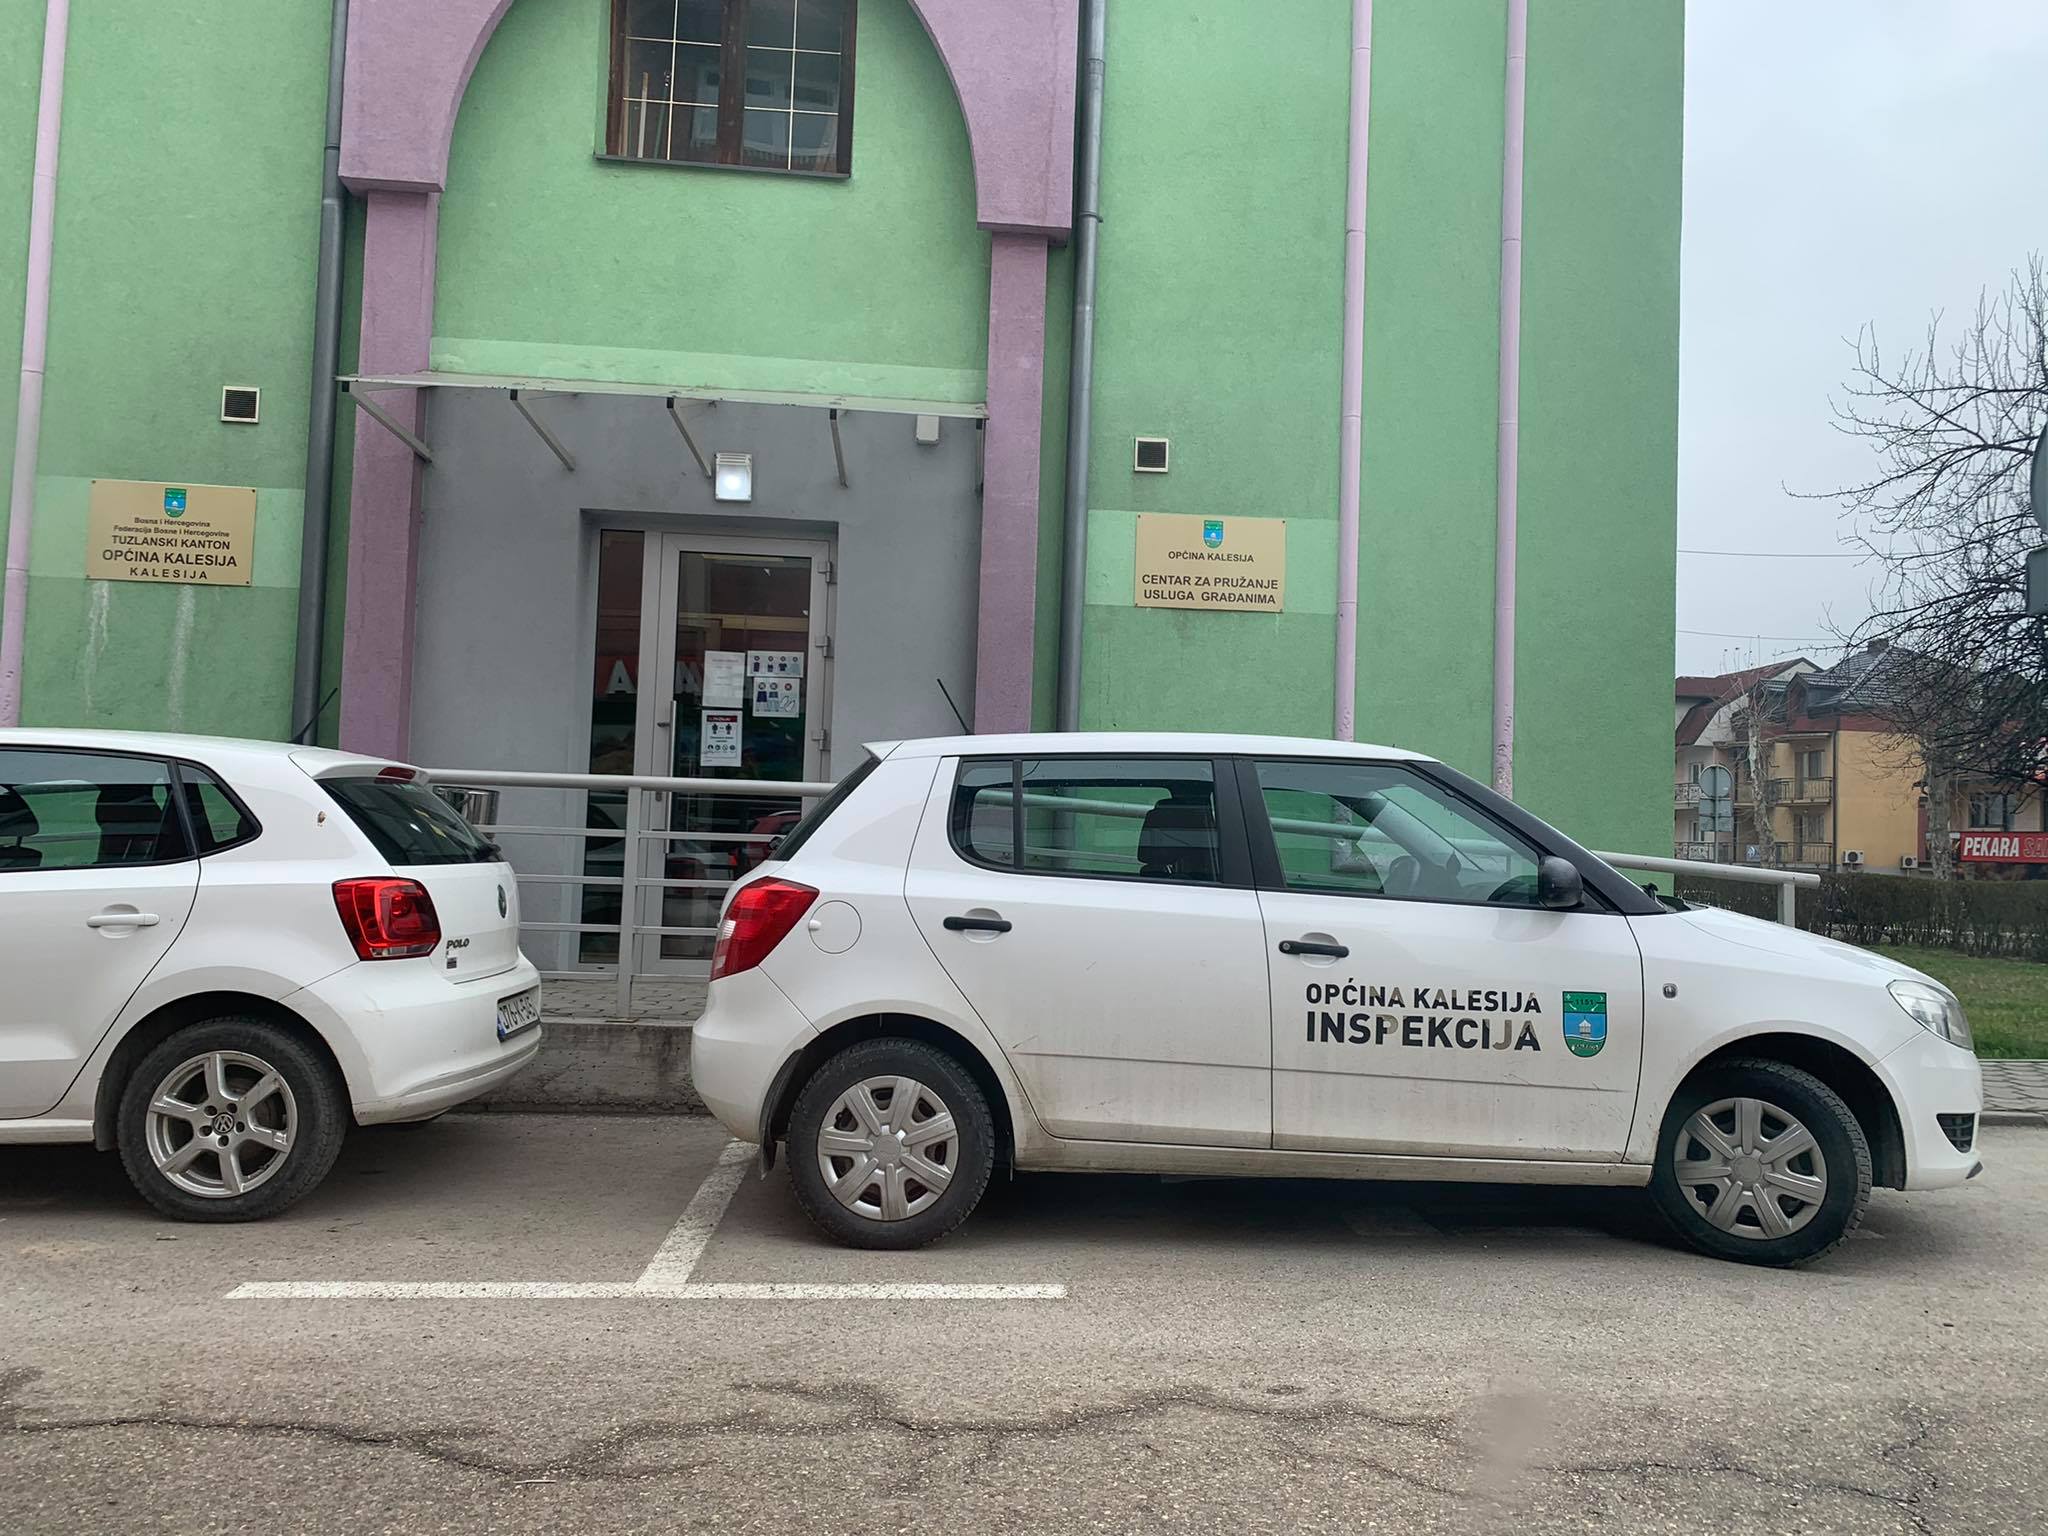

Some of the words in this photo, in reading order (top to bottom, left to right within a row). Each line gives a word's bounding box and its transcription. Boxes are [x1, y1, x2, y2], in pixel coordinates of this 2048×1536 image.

[164, 519, 210, 527] Hercegovina
[113, 525, 152, 534] Federacija
[183, 530, 230, 538] Hercegovine
[112, 535, 178, 547] TUZLANSKI
[181, 539, 230, 550] KANTON
[102, 548, 160, 563] OPĆINA
[164, 552, 237, 567] KALESIJA
[1207, 553, 1254, 562] KALESIJA
[1142, 574, 1191, 586] CENTAR
[1195, 577, 1211, 587] ZA
[1214, 576, 1278, 590] PRUŽANJE
[1144, 589, 1195, 601] USLUGA
[1201, 592, 1276, 604] GRAĐANIMA
[1963, 837, 2019, 857] PEKARA
[446, 938, 470, 949] POLO
[1306, 978, 1405, 1008] OPĆINA
[1414, 988, 1542, 1013] KALESIJA
[1306, 1011, 1542, 1051] INSPEKCIJA
